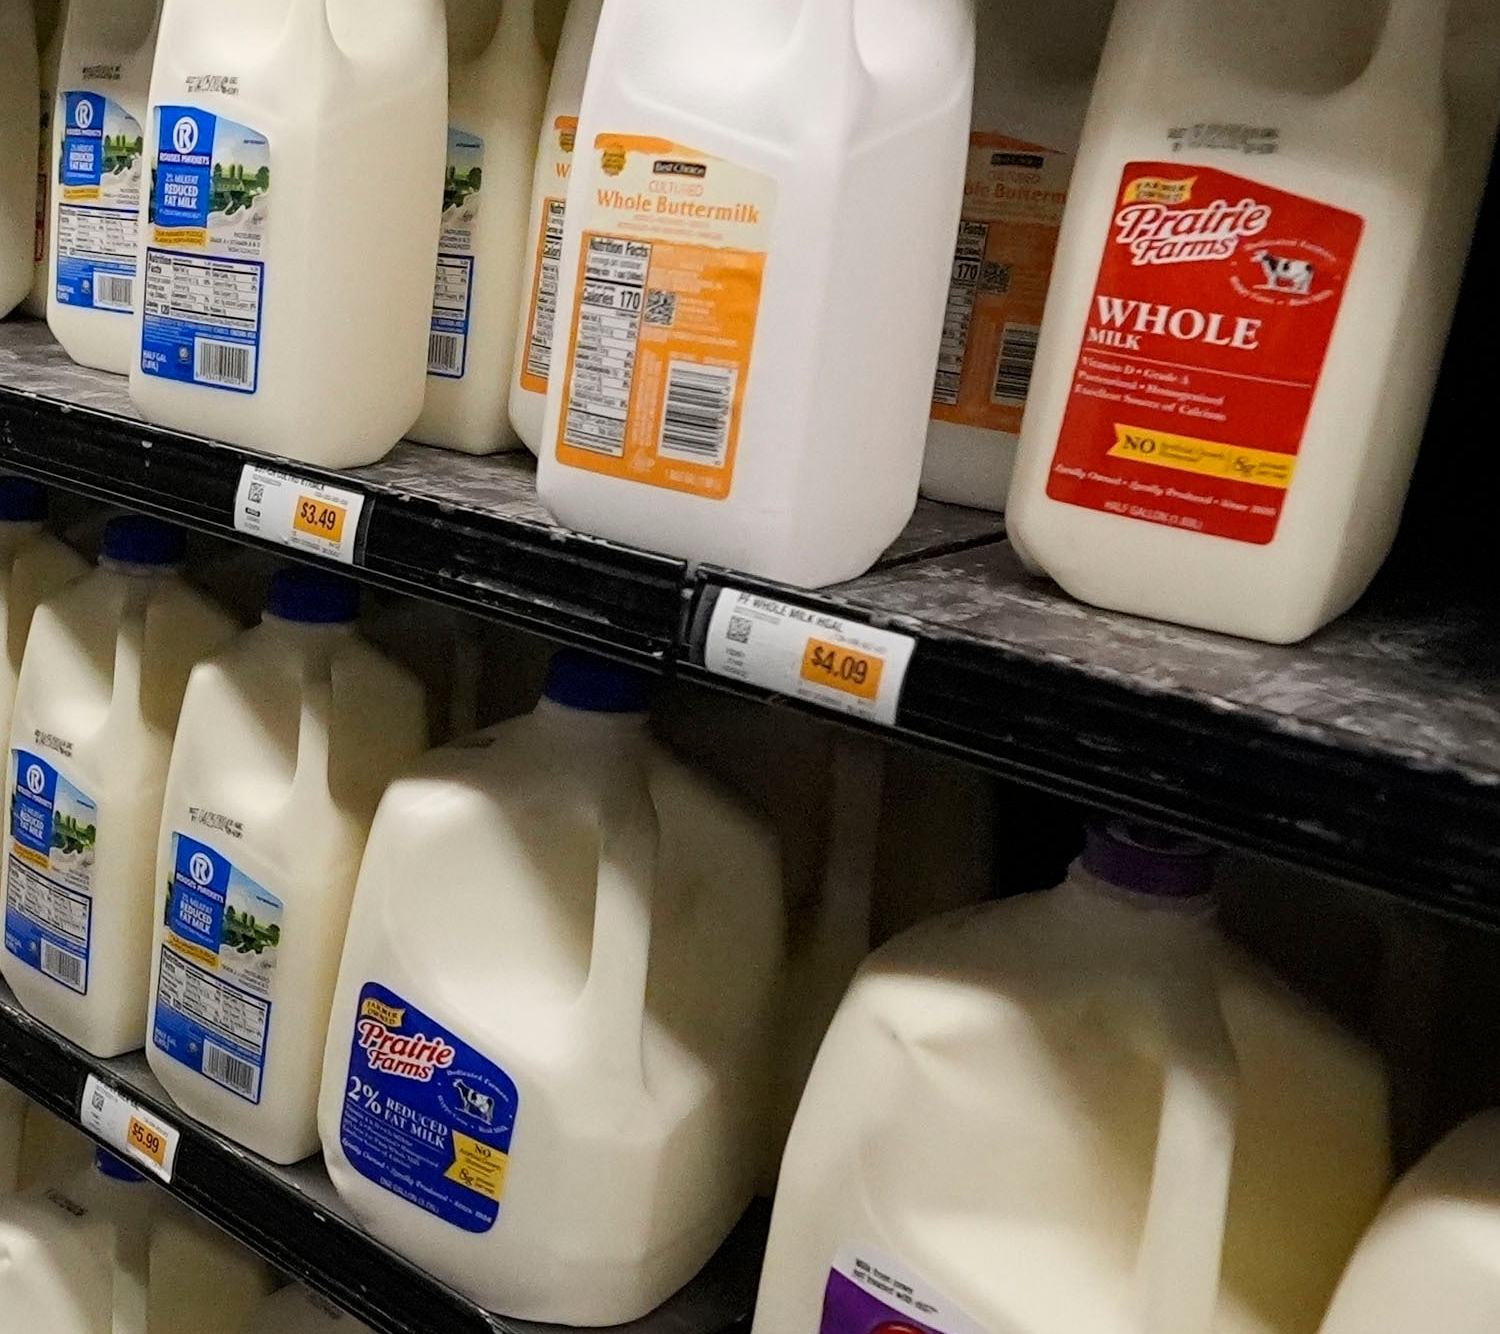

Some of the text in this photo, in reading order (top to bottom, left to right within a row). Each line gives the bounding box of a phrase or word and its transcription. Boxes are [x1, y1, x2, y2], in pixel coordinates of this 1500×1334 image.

[164, 184, 199, 197] REDUCED
[164, 195, 197, 209] FAT MILK
[597, 189, 760, 225] Whole Buttermilk
[1116, 198, 1271, 244] Prairie
[590, 237, 649, 258] Nutrition Facts
[1131, 234, 1239, 266] Farms
[957, 263, 978, 281] 170
[582, 287, 641, 311] Calories 170
[1098, 295, 1262, 350] WHOLE
[1087, 327, 1142, 351] MILK
[1122, 434, 1156, 455] NO
[301, 501, 337, 531] $3.49
[752, 598, 788, 616] WHOLE
[810, 646, 868, 685] $4.09
[180, 902, 213, 925] REDUCED
[192, 917, 212, 935] MILK
[366, 1000, 399, 1018] FARMER
[367, 1008, 396, 1024] OWNED
[358, 1019, 455, 1069] Prairie
[368, 1048, 434, 1082] Farms
[348, 1076, 448, 1136] 2% REDUCED
[132, 1123, 160, 1154] $5.99
[385, 1109, 445, 1150] FAT MILK
[474, 1144, 491, 1158] NO
